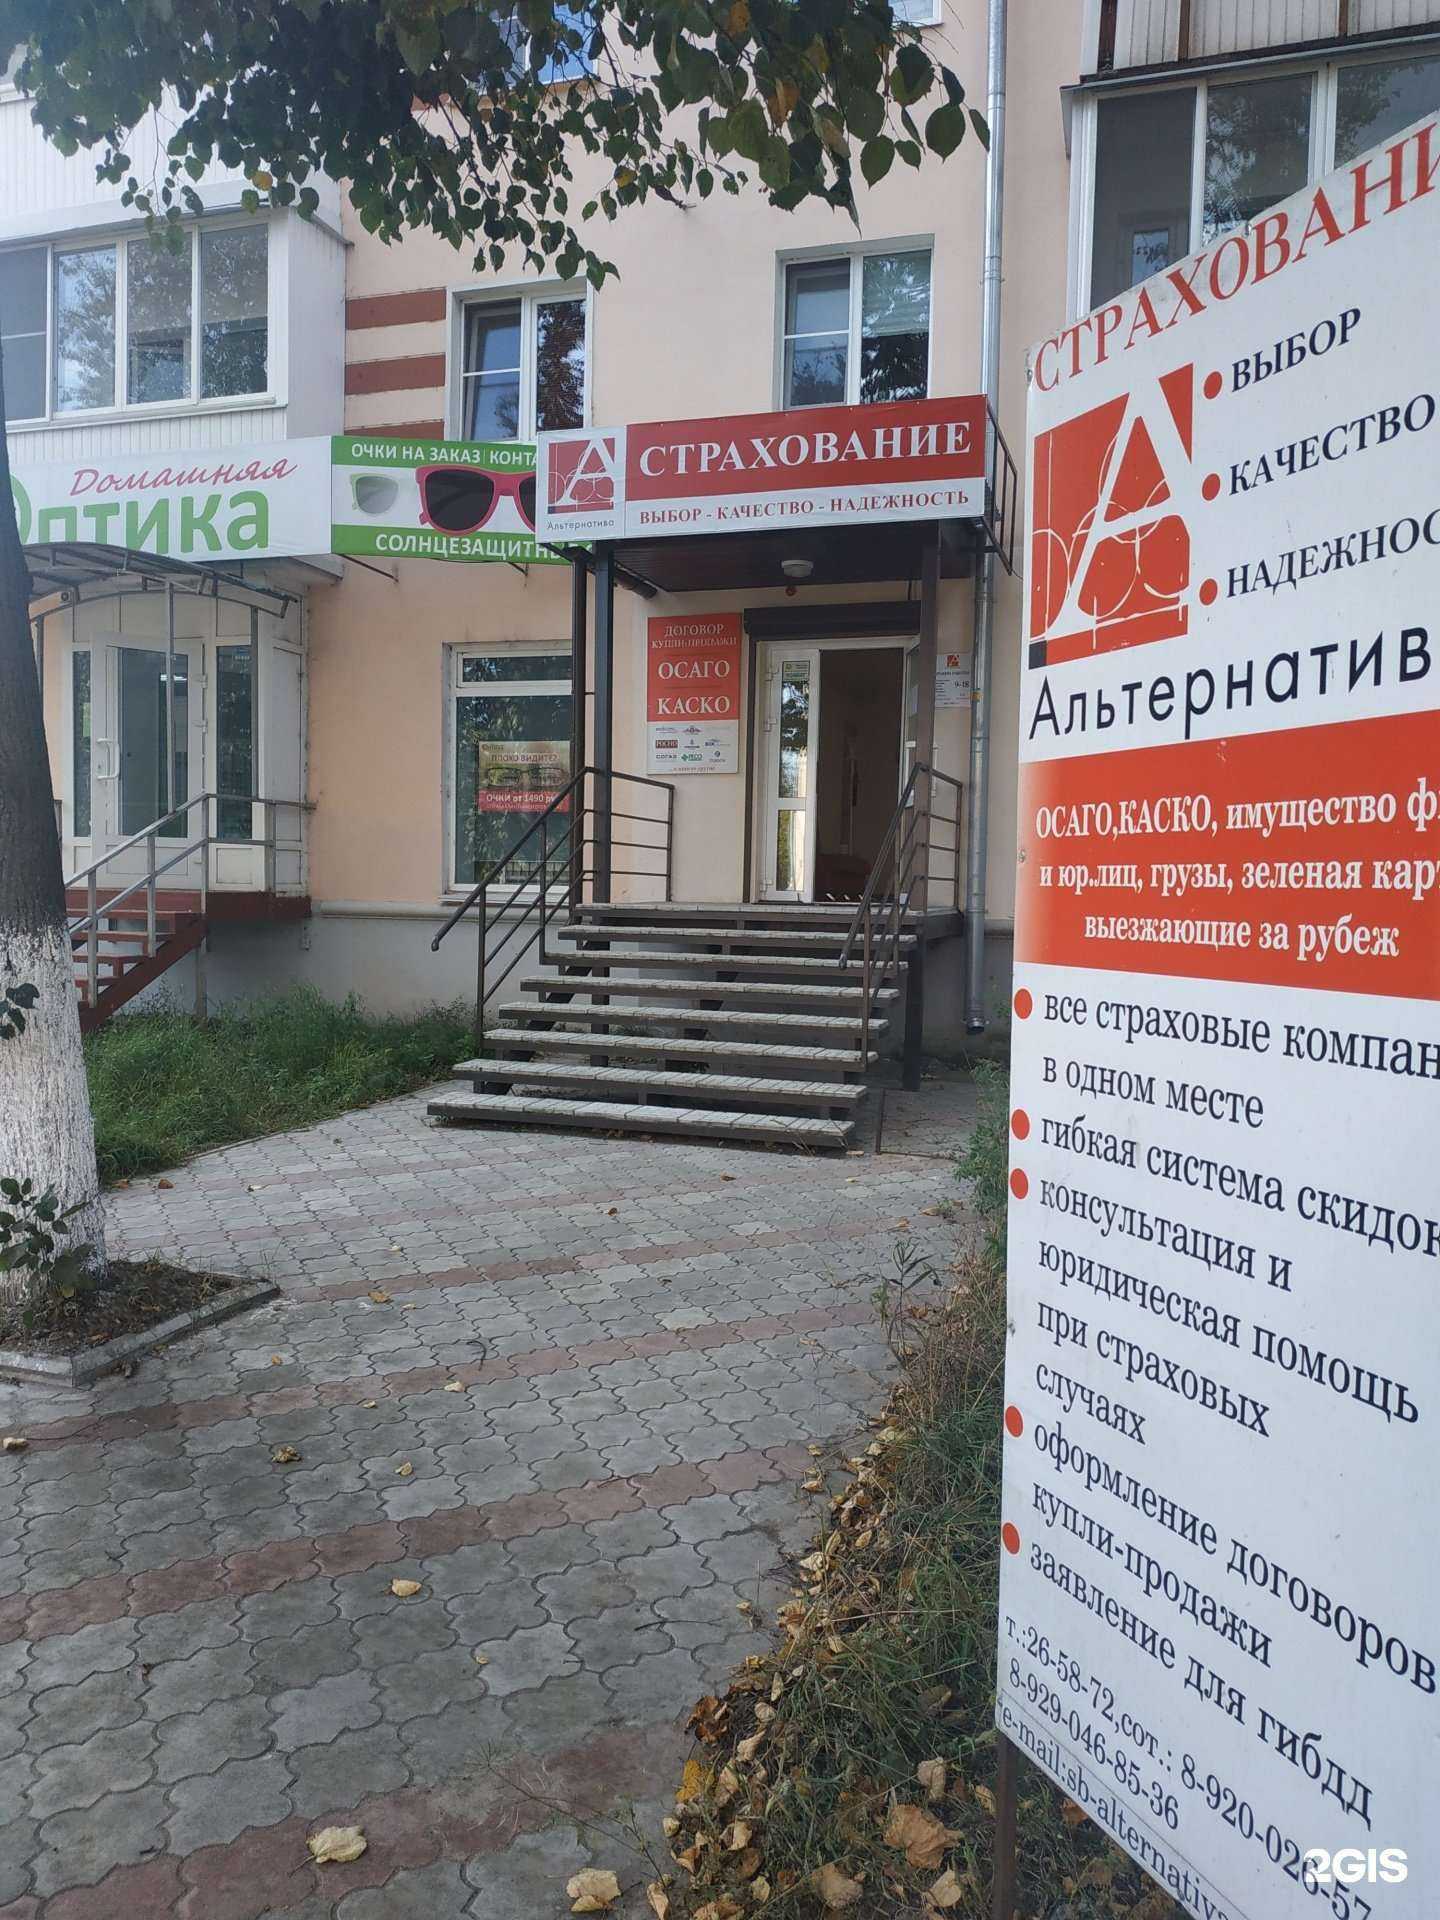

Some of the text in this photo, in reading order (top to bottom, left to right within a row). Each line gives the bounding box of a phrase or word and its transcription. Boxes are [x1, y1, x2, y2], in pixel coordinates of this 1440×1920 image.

[1231, 307, 1361, 393] ВЫБОР
[70, 458, 298, 497] Домашняя
[352, 443, 397, 459] ОЧКИ
[402, 446, 424, 461] НА
[429, 448, 481, 464] ЗАКАЗ
[639, 422, 971, 477] СТРАХОВАНИЕ
[1229, 393, 1436, 496] КАЧЕСТВО
[546, 520, 615, 530] Альтернатива
[640, 508, 703, 525] ВЫБОР
[717, 499, 814, 519] КАЧЕСТВО
[830, 488, 969, 513] НАДЕЖНОСТЬ
[664, 624, 724, 638] ДОГОВОР
[657, 696, 730, 715] КАСКО
[658, 660, 730, 679] ОСАГО
[1029, 626, 1432, 741] Альтернатив
[1225, 792, 1396, 837] имущество
[1407, 777, 1440, 832] ф
[1039, 858, 1440, 900] и юр.лиц, грузы, зеленая кар
[1084, 912, 1400, 962] выезжающие за рубеж
[1044, 993, 1087, 1025] все
[1096, 1000, 1271, 1053] страховые
[1043, 1056, 1264, 1129] в одном месте
[1041, 1114, 1137, 1169] гибкая
[1146, 1145, 1286, 1212] система
[1040, 1179, 1293, 1292] консультация и
[1038, 1240, 1419, 1424] юридическая помощь
[1036, 1363, 1147, 1446] случаях
[1037, 1301, 1270, 1439] при страховых
[1032, 1482, 1273, 1669] купли-продажи
[1034, 1421, 1437, 1695] оформление договоров
[1031, 1541, 1373, 1832] заявление для гибдд
[1009, 1657, 1179, 1830] 8-929-046-85-36
